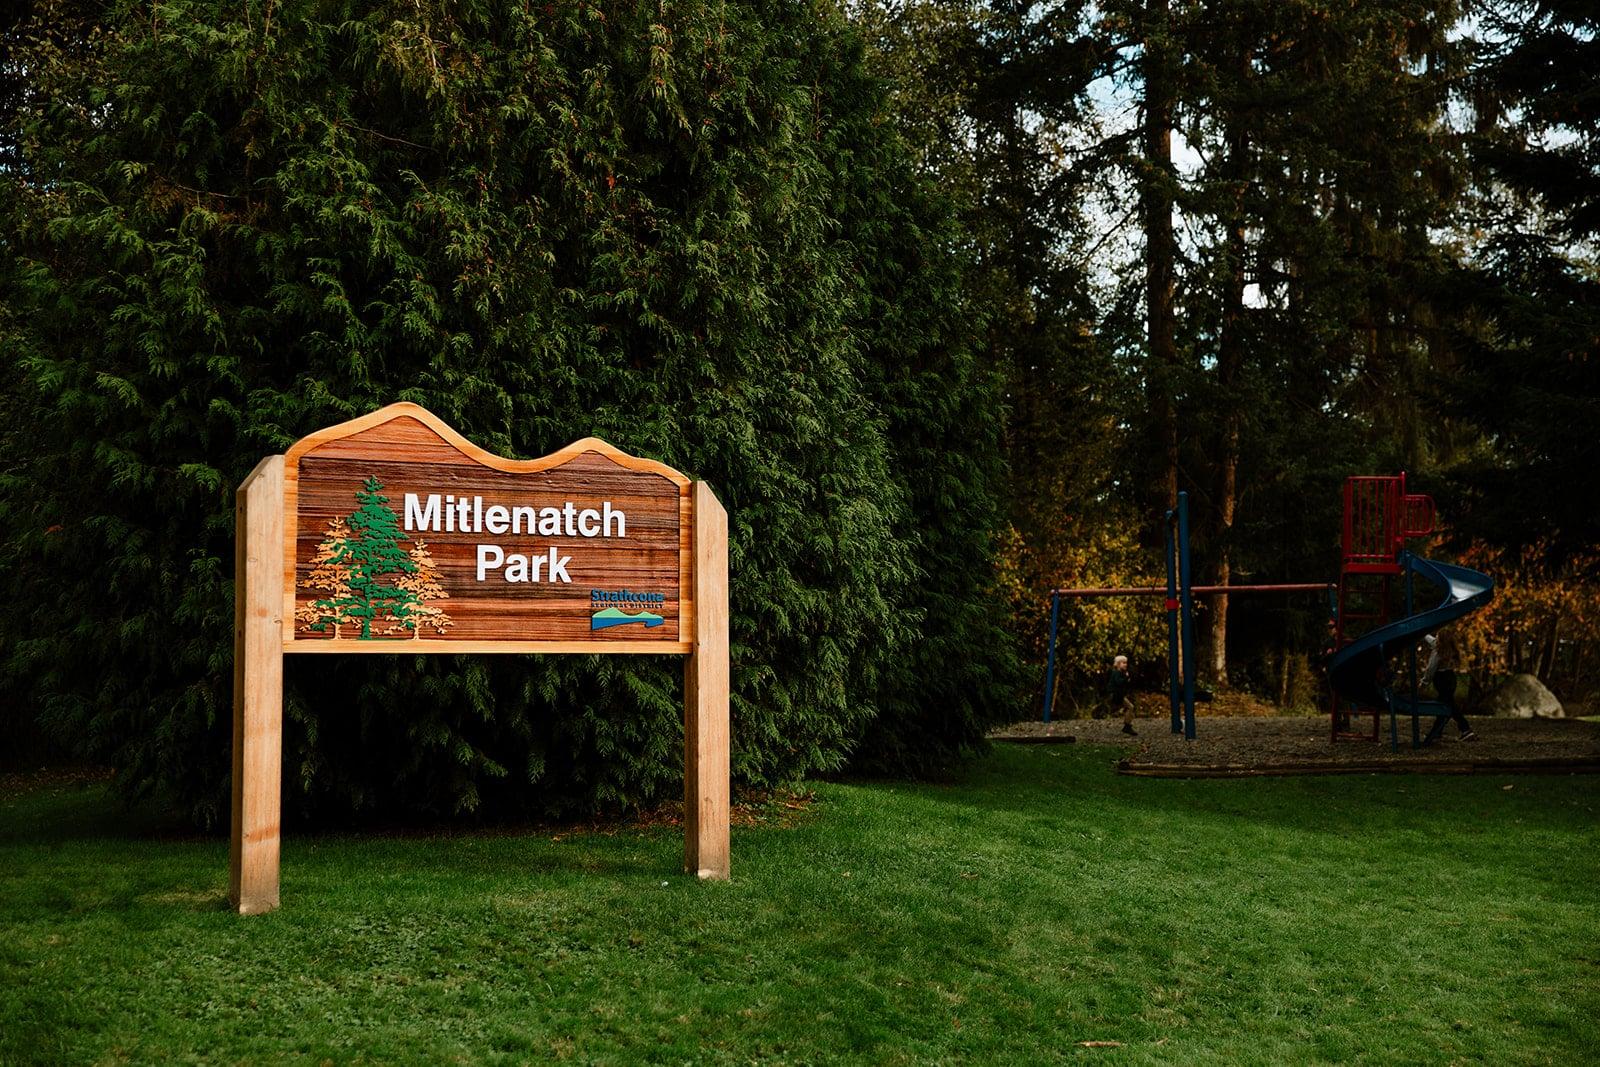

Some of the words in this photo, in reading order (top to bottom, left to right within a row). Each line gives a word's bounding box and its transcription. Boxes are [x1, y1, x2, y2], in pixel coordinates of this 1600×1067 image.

[404, 493, 626, 537] Mitlenatch
[476, 545, 572, 583] Park
[591, 588, 664, 602] Strathcona
